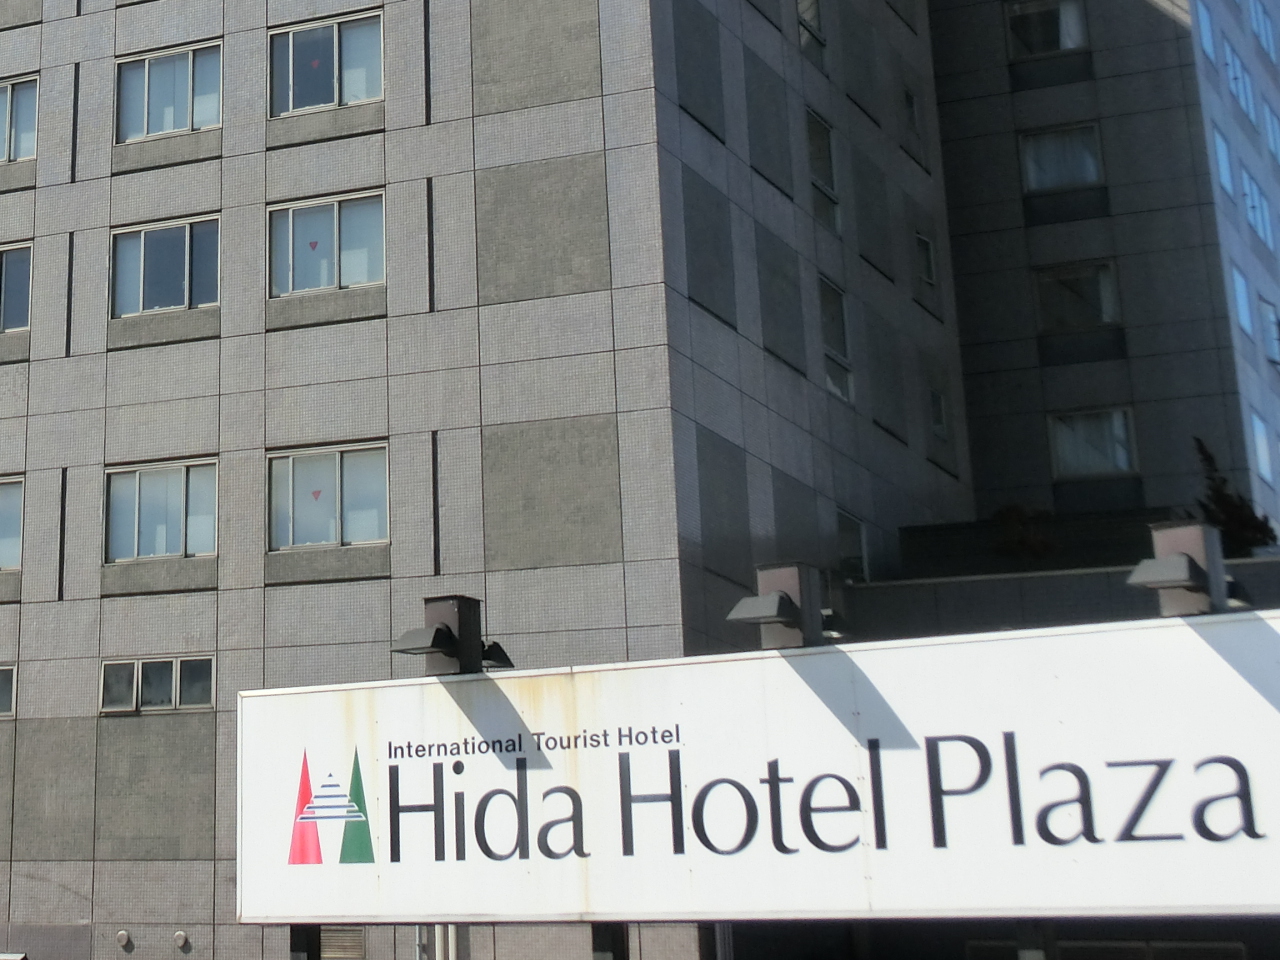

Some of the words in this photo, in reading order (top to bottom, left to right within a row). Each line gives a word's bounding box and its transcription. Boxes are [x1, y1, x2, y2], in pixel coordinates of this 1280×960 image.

[388, 735, 523, 759] International
[532, 729, 610, 751] Tourist
[617, 724, 681, 746] Hotel
[388, 757, 591, 863] Hida
[618, 739, 887, 856] Hotel
[924, 731, 1267, 848] Plaza
